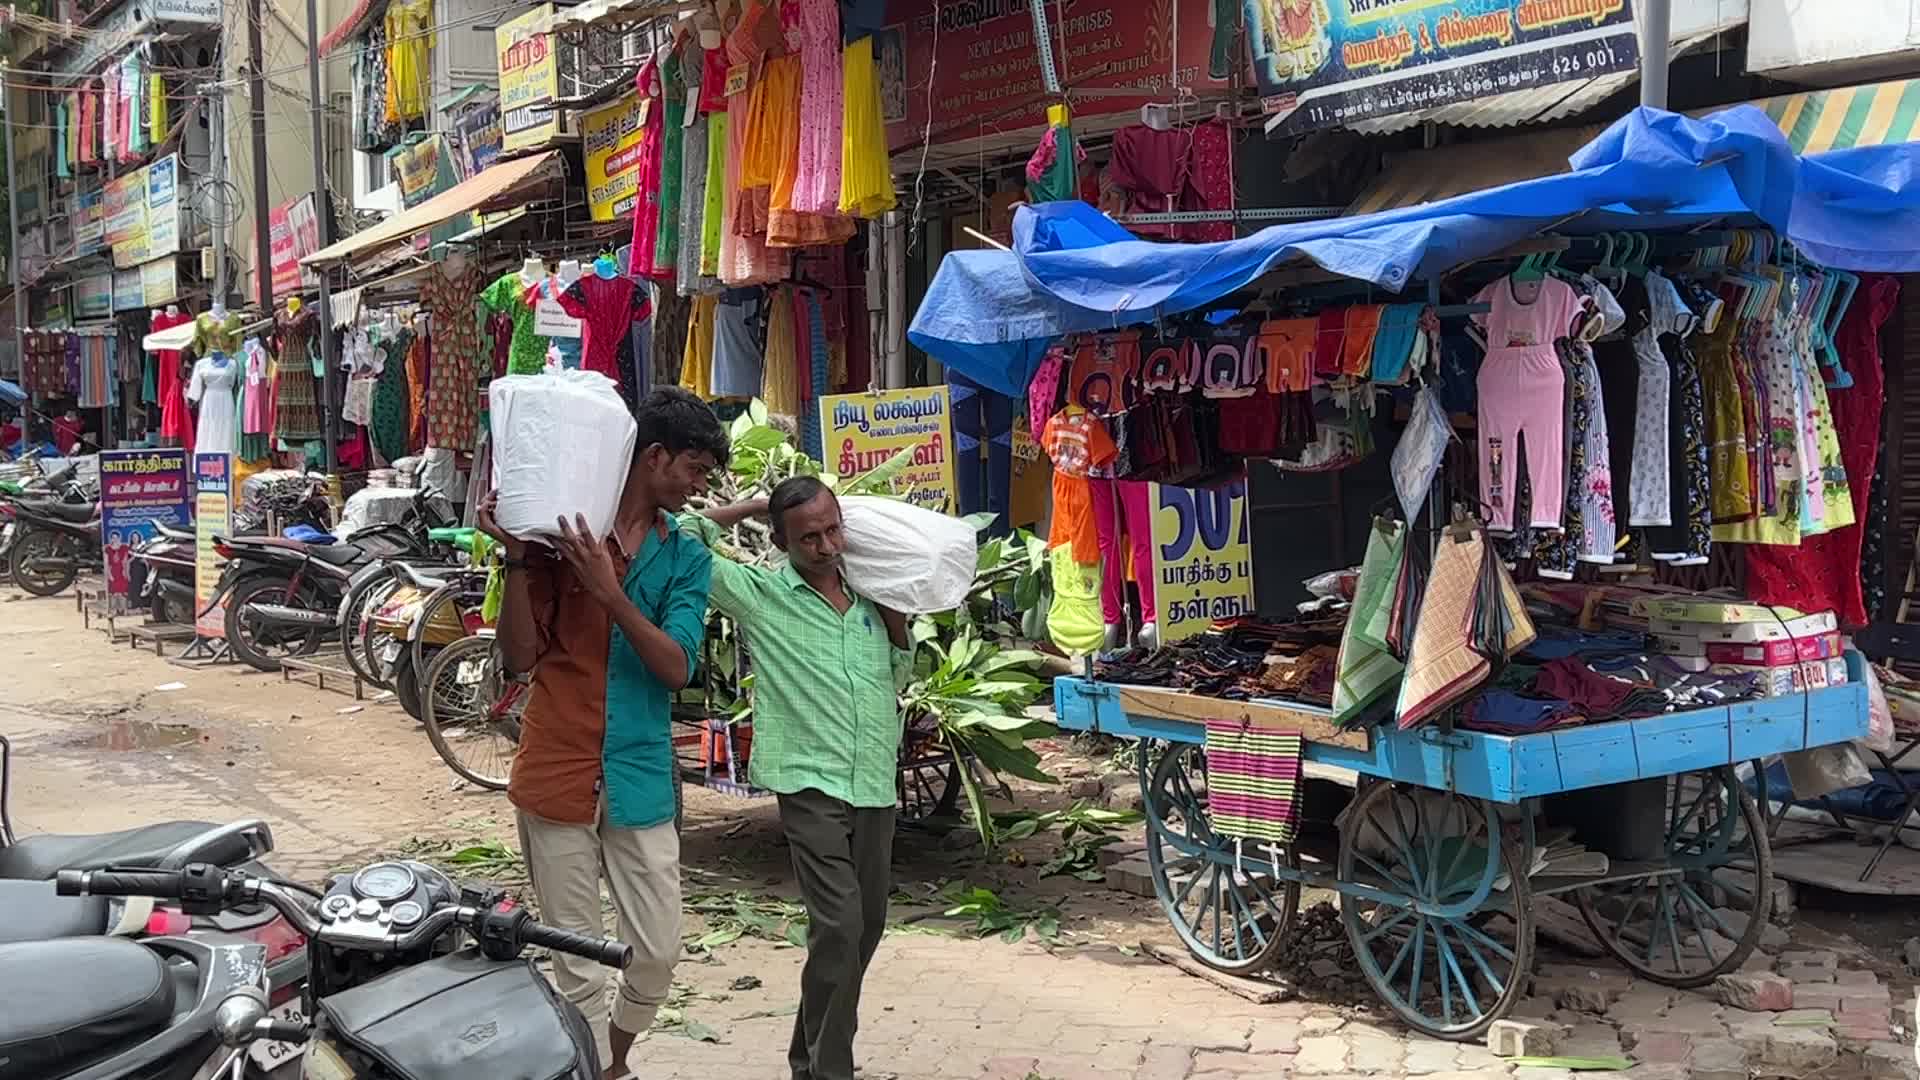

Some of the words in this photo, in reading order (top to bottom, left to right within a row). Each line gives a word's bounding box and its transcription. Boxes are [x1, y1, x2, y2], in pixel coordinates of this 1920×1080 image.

[1419, 23, 1431, 49] &
[1552, 55, 1581, 75] 626
[1163, 555, 1232, 588] பாதிக்கு
